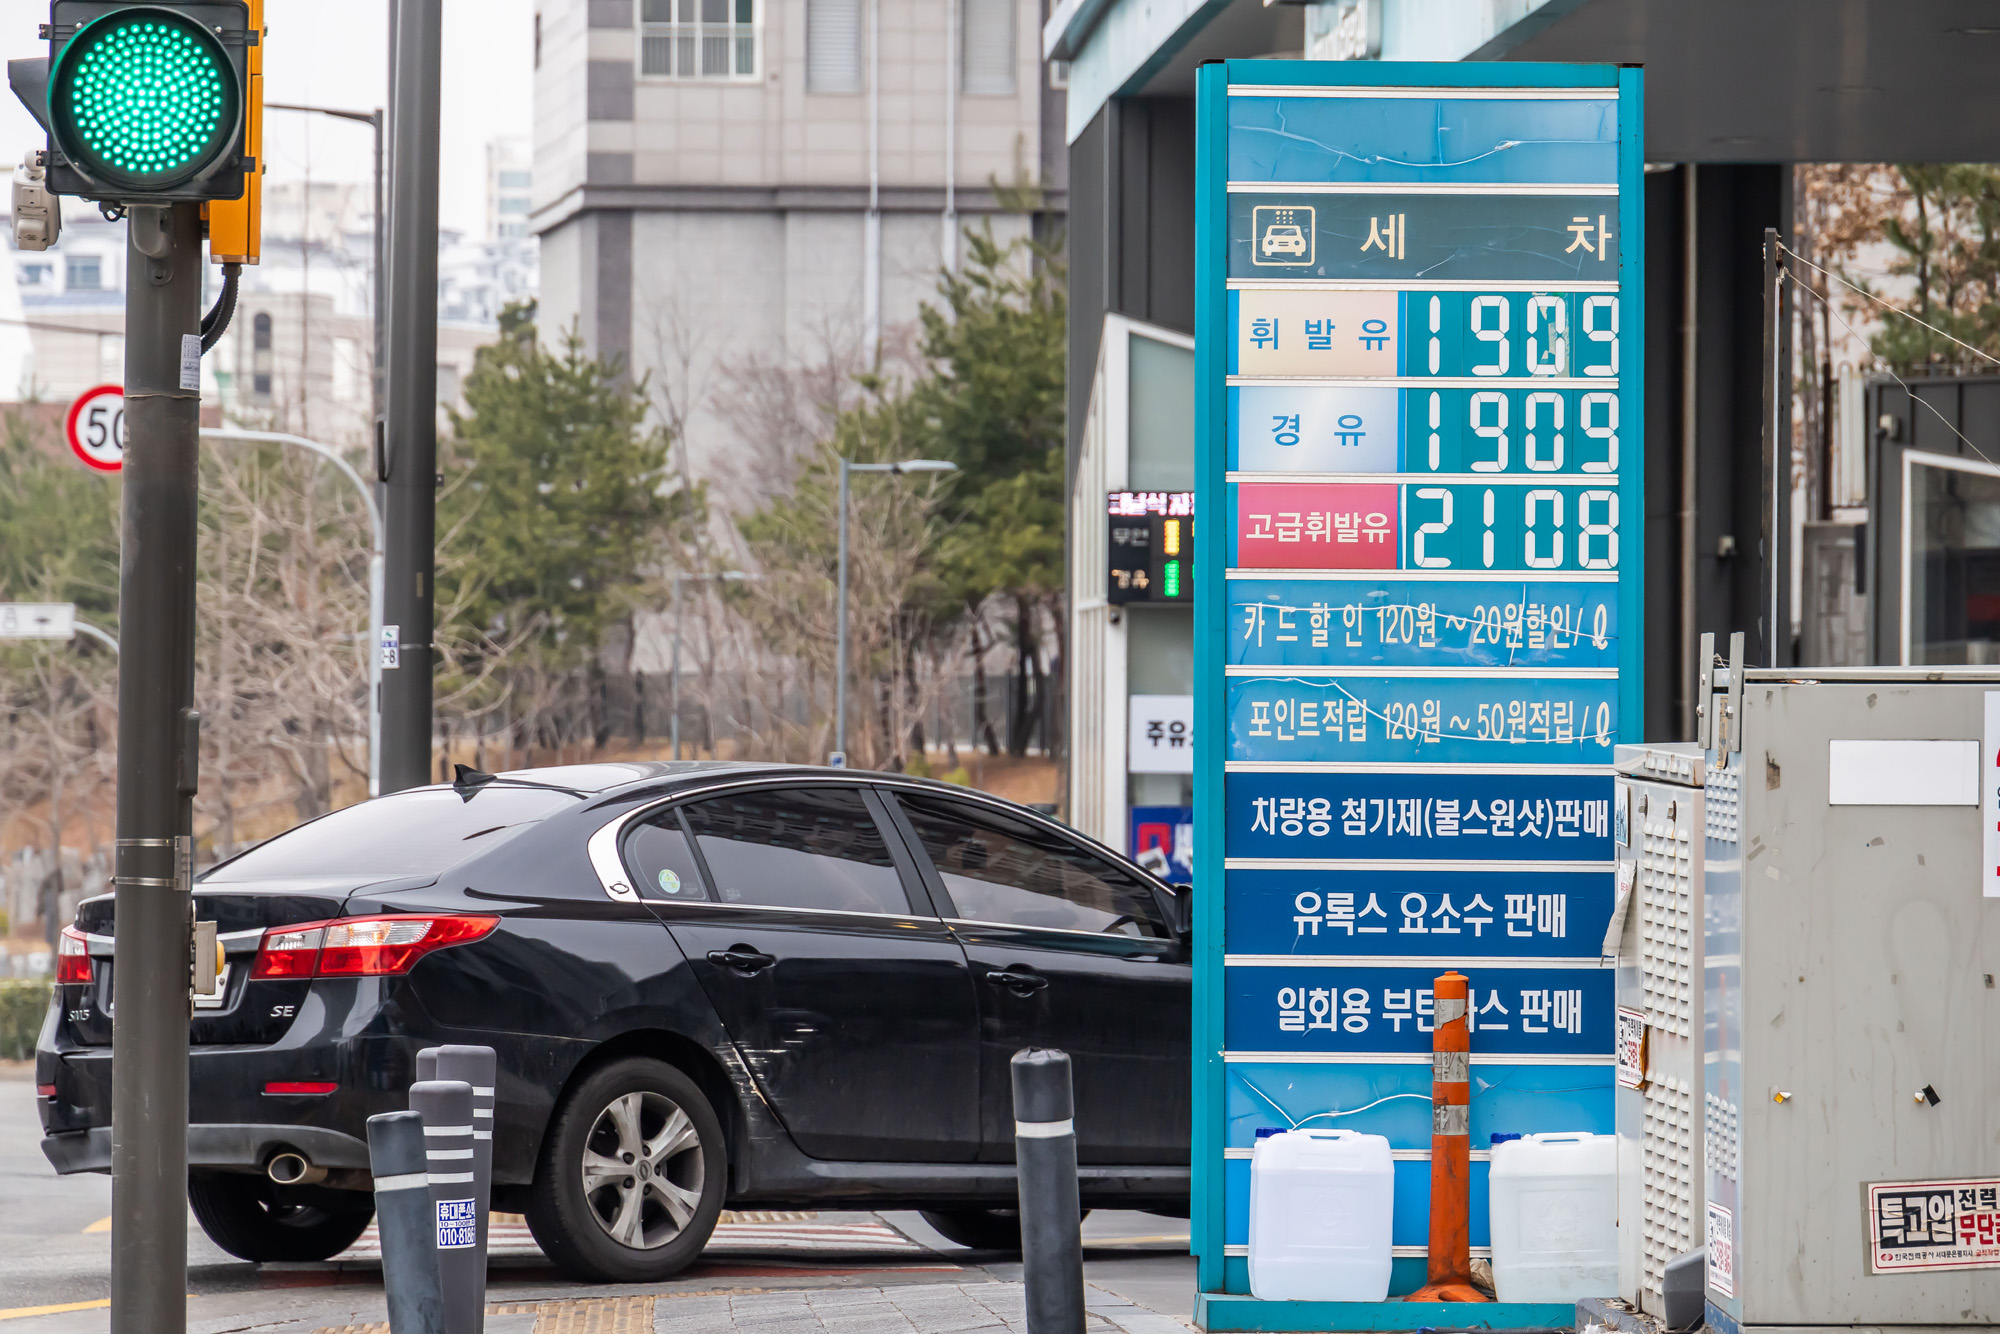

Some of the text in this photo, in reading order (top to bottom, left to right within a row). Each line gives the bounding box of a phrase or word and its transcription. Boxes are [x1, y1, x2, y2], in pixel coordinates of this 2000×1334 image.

[1428, 295, 1620, 377] 1909
[1428, 391, 1620, 473] 1909
[1245, 511, 1391, 544] 고급휘발유
[1413, 487, 1620, 570] 2108
[1377, 602, 1437, 648] 120원
[1148, 720, 1194, 747] 주유
[1248, 698, 1368, 742] 포인트적립
[1383, 699, 1442, 743] 120원
[1250, 797, 1332, 837] 차량용
[1293, 891, 1567, 938] 유록스 요소수 판매
[270, 1005, 295, 1018] SE
[1277, 986, 1371, 1034] 일회용
[1520, 989, 1582, 1034] 판매
[1880, 1194, 1954, 1245] 특고압
